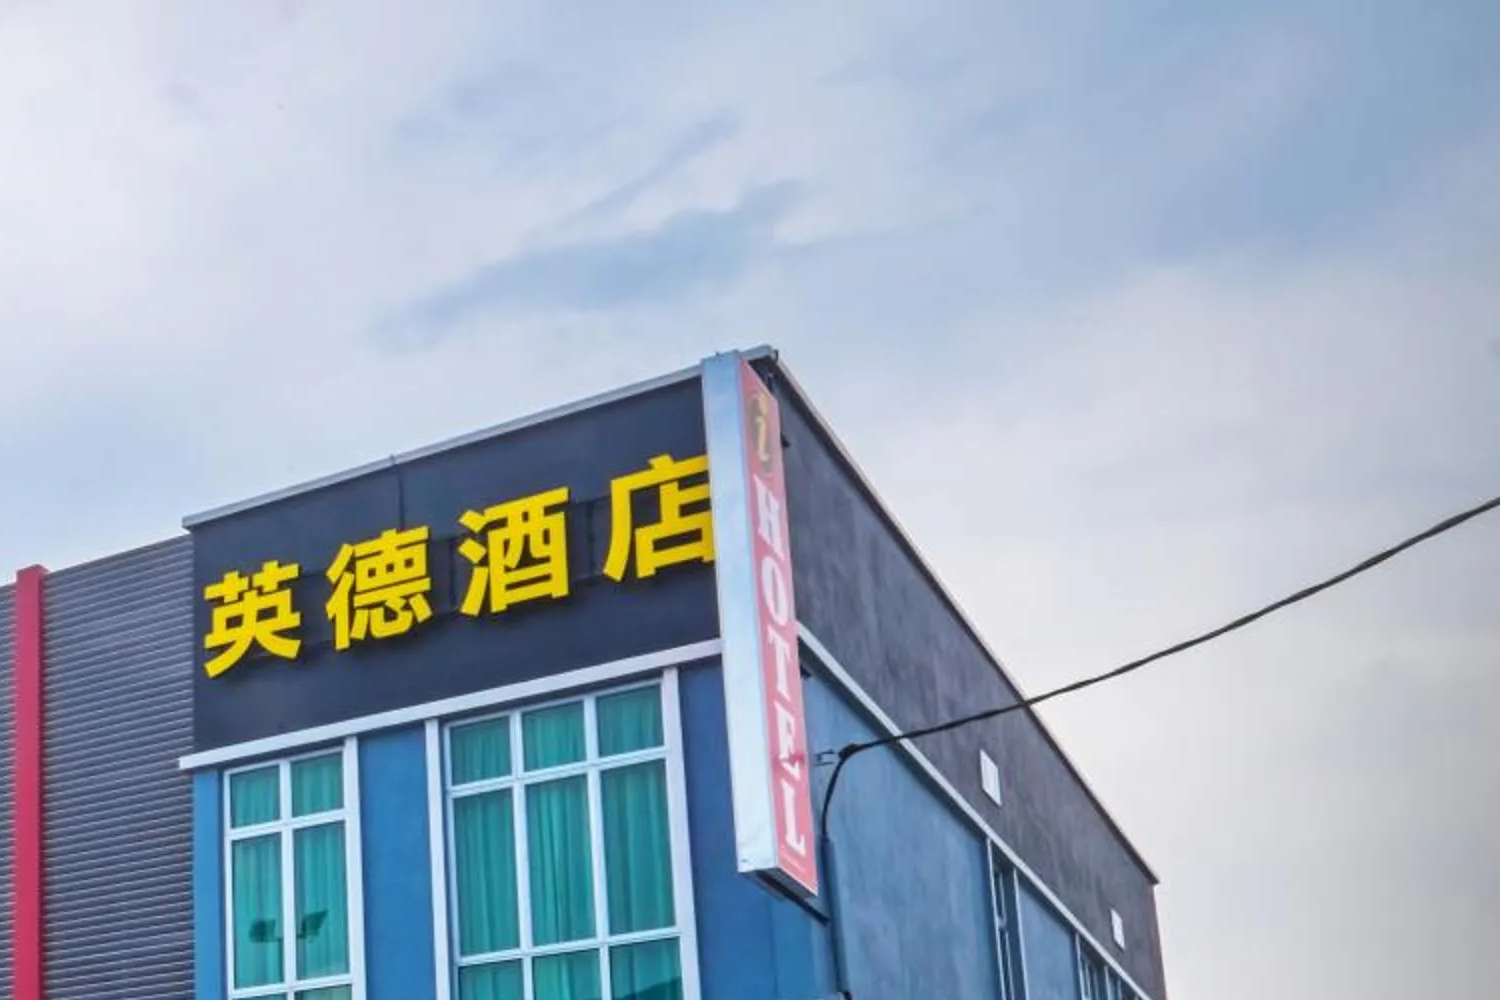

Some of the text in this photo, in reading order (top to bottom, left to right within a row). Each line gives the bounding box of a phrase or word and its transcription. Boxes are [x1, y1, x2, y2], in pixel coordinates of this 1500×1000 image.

[203, 453, 715, 678] 英德酒店
[753, 473, 806, 857] HOTEL
